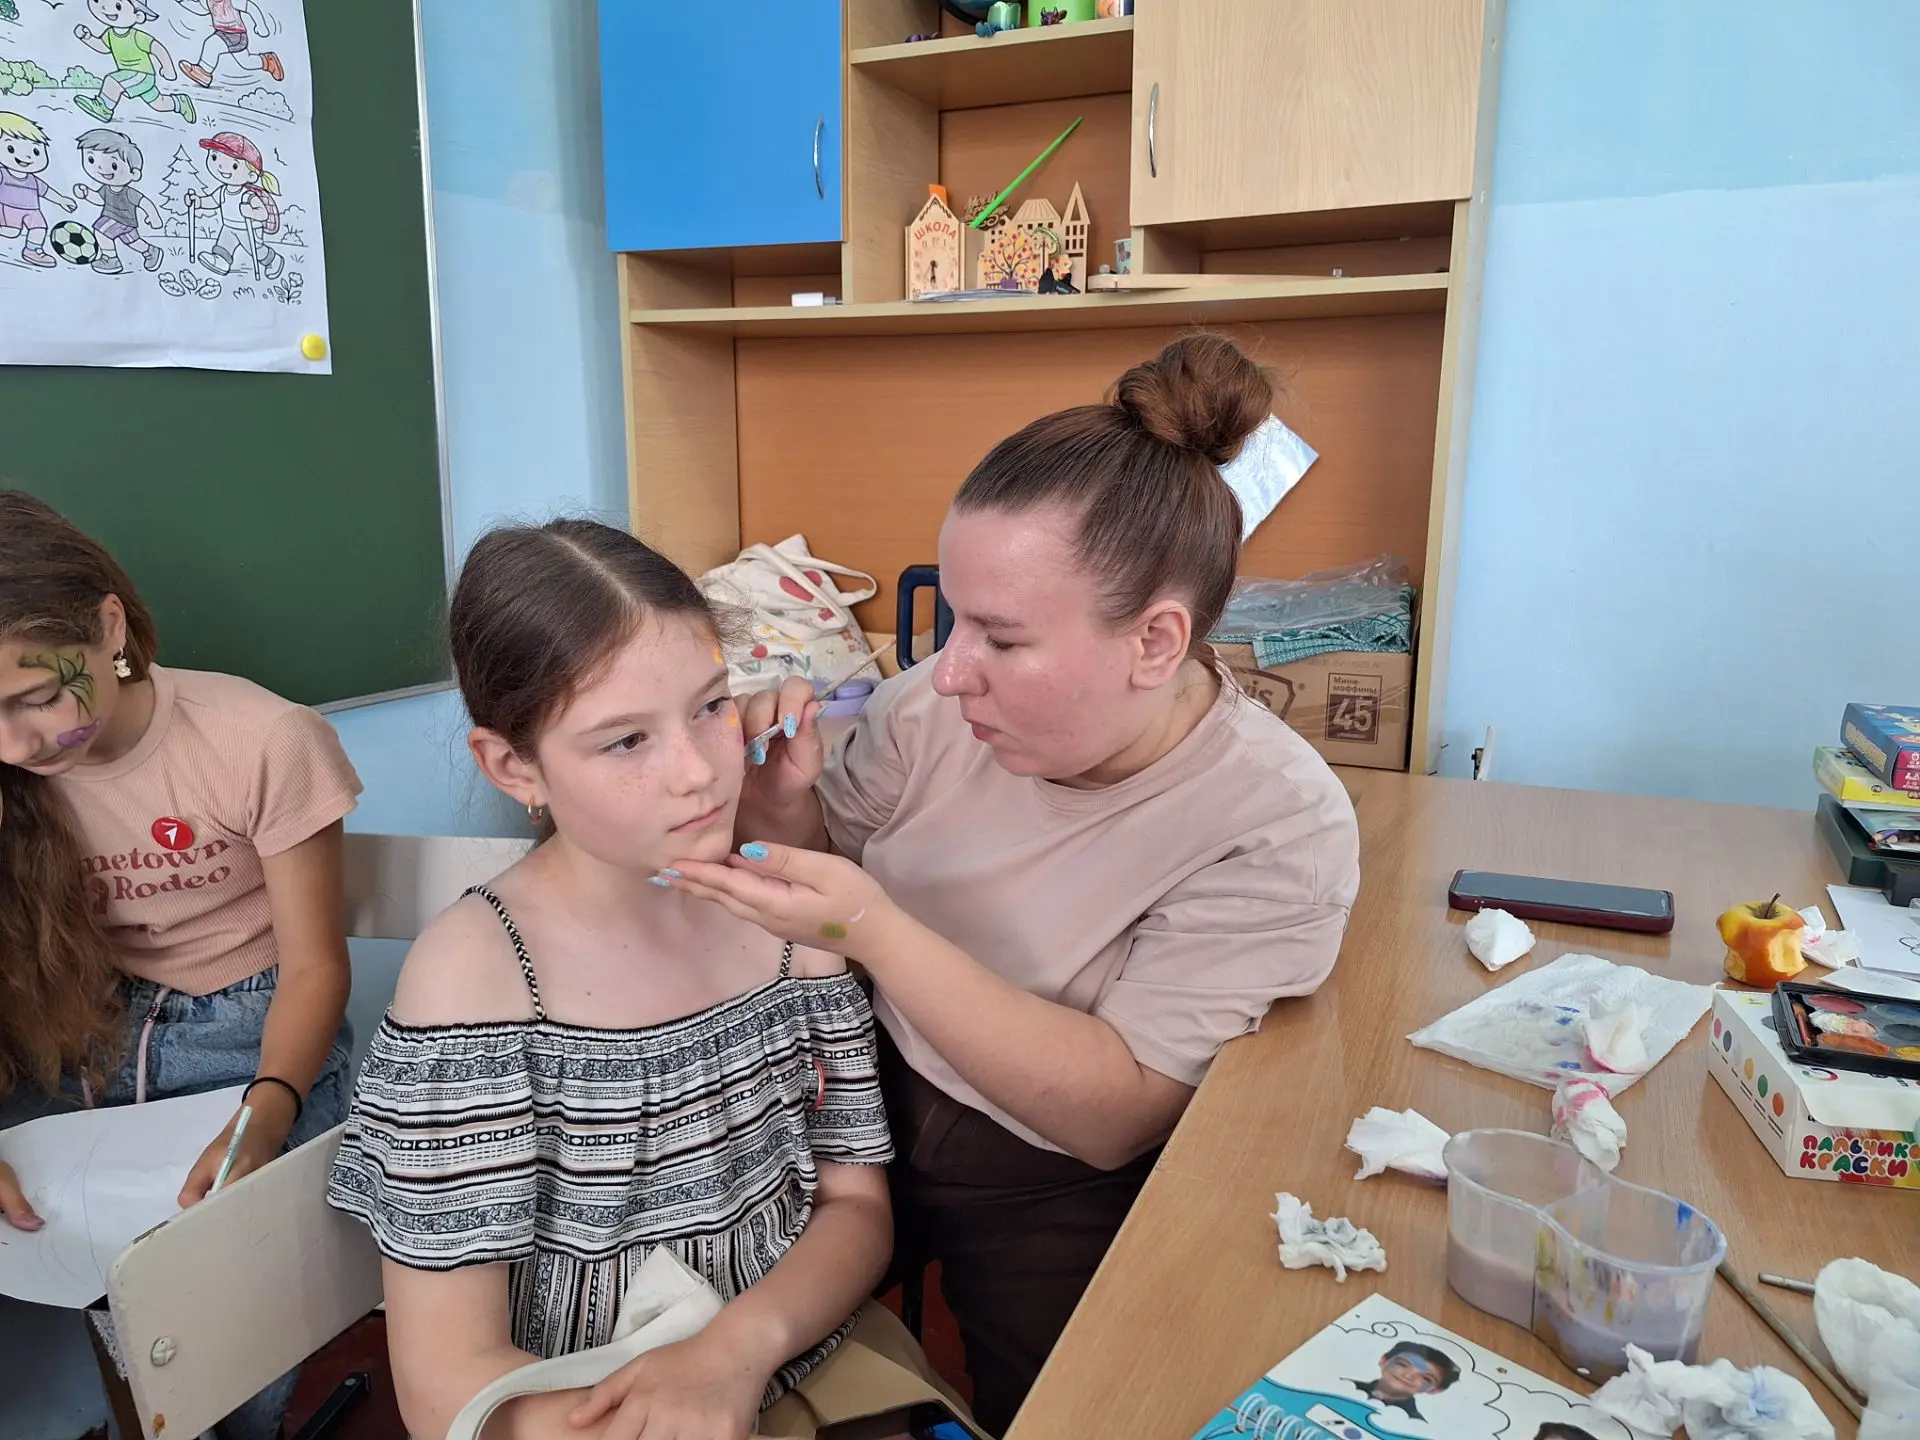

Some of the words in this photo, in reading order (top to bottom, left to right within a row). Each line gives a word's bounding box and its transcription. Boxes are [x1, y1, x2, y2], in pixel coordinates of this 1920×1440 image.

[914, 221, 957, 240] ШКОЛА
[1333, 698, 1373, 731] 45
[113, 866, 231, 900] Rodeo
[1800, 1151, 1908, 1177] КРАСКИ
